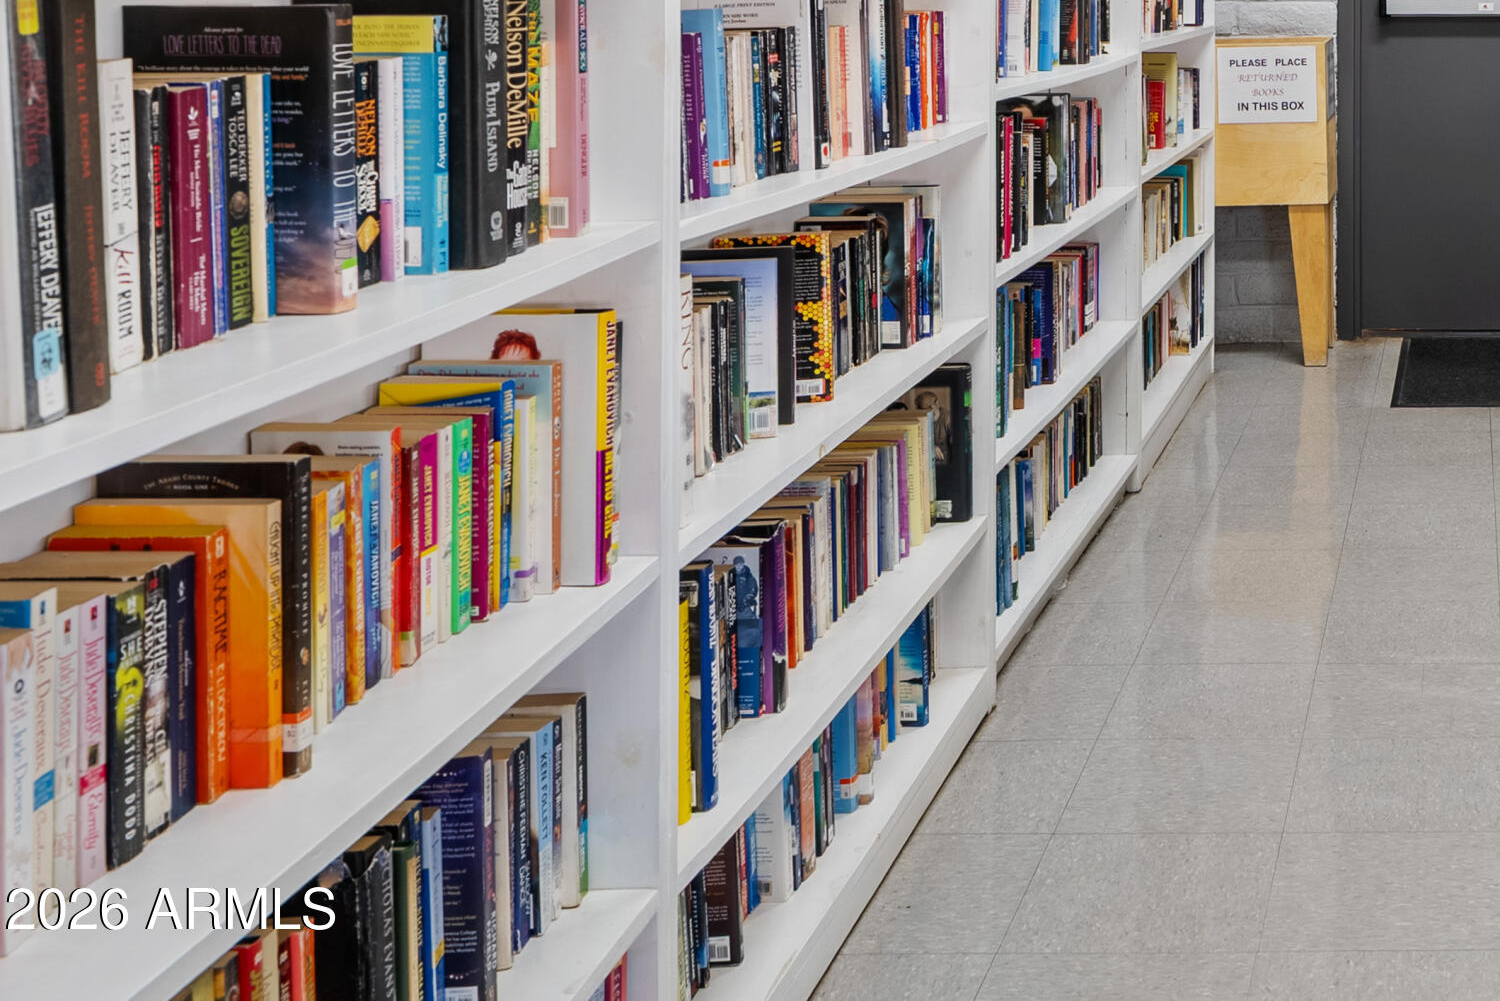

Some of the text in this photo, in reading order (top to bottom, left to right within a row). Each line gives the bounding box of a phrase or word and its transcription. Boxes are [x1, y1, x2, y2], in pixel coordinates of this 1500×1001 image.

[506, 0, 528, 149] Nelson DeMille
[527, 10, 539, 122] THE MAZE
[1229, 58, 1307, 67] PLEASE PLACE
[1238, 72, 1298, 82] RETURNED
[1252, 88, 1285, 97] BOOKS
[228, 116, 238, 179] TOSCA LEE
[237, 108, 247, 183] TED DEKKER
[365, 98, 376, 155] NELSON
[436, 55, 447, 169] Barbara Delinsky
[486, 81, 502, 172] PLUM ISLAND
[1237, 101, 1304, 111] IN THIS BOX
[119, 129, 133, 210] JEFFERY
[230, 224, 251, 323] SOVEREIGN
[606, 320, 616, 447] JANET EVANOVICH
[423, 464, 433, 546] JANET EVANOVICH
[457, 474, 472, 593] JANET EVANOVICH
[369, 499, 380, 609] JANET EVANOVICH
[154, 598, 168, 681] STEPHEN
[710, 659, 718, 726] DRAGON
[124, 693, 137, 842] CHRISTINA DODD
[518, 750, 527, 859] CHRISTINE FEEHAN
[540, 751, 549, 840] KEN FOLLETT
